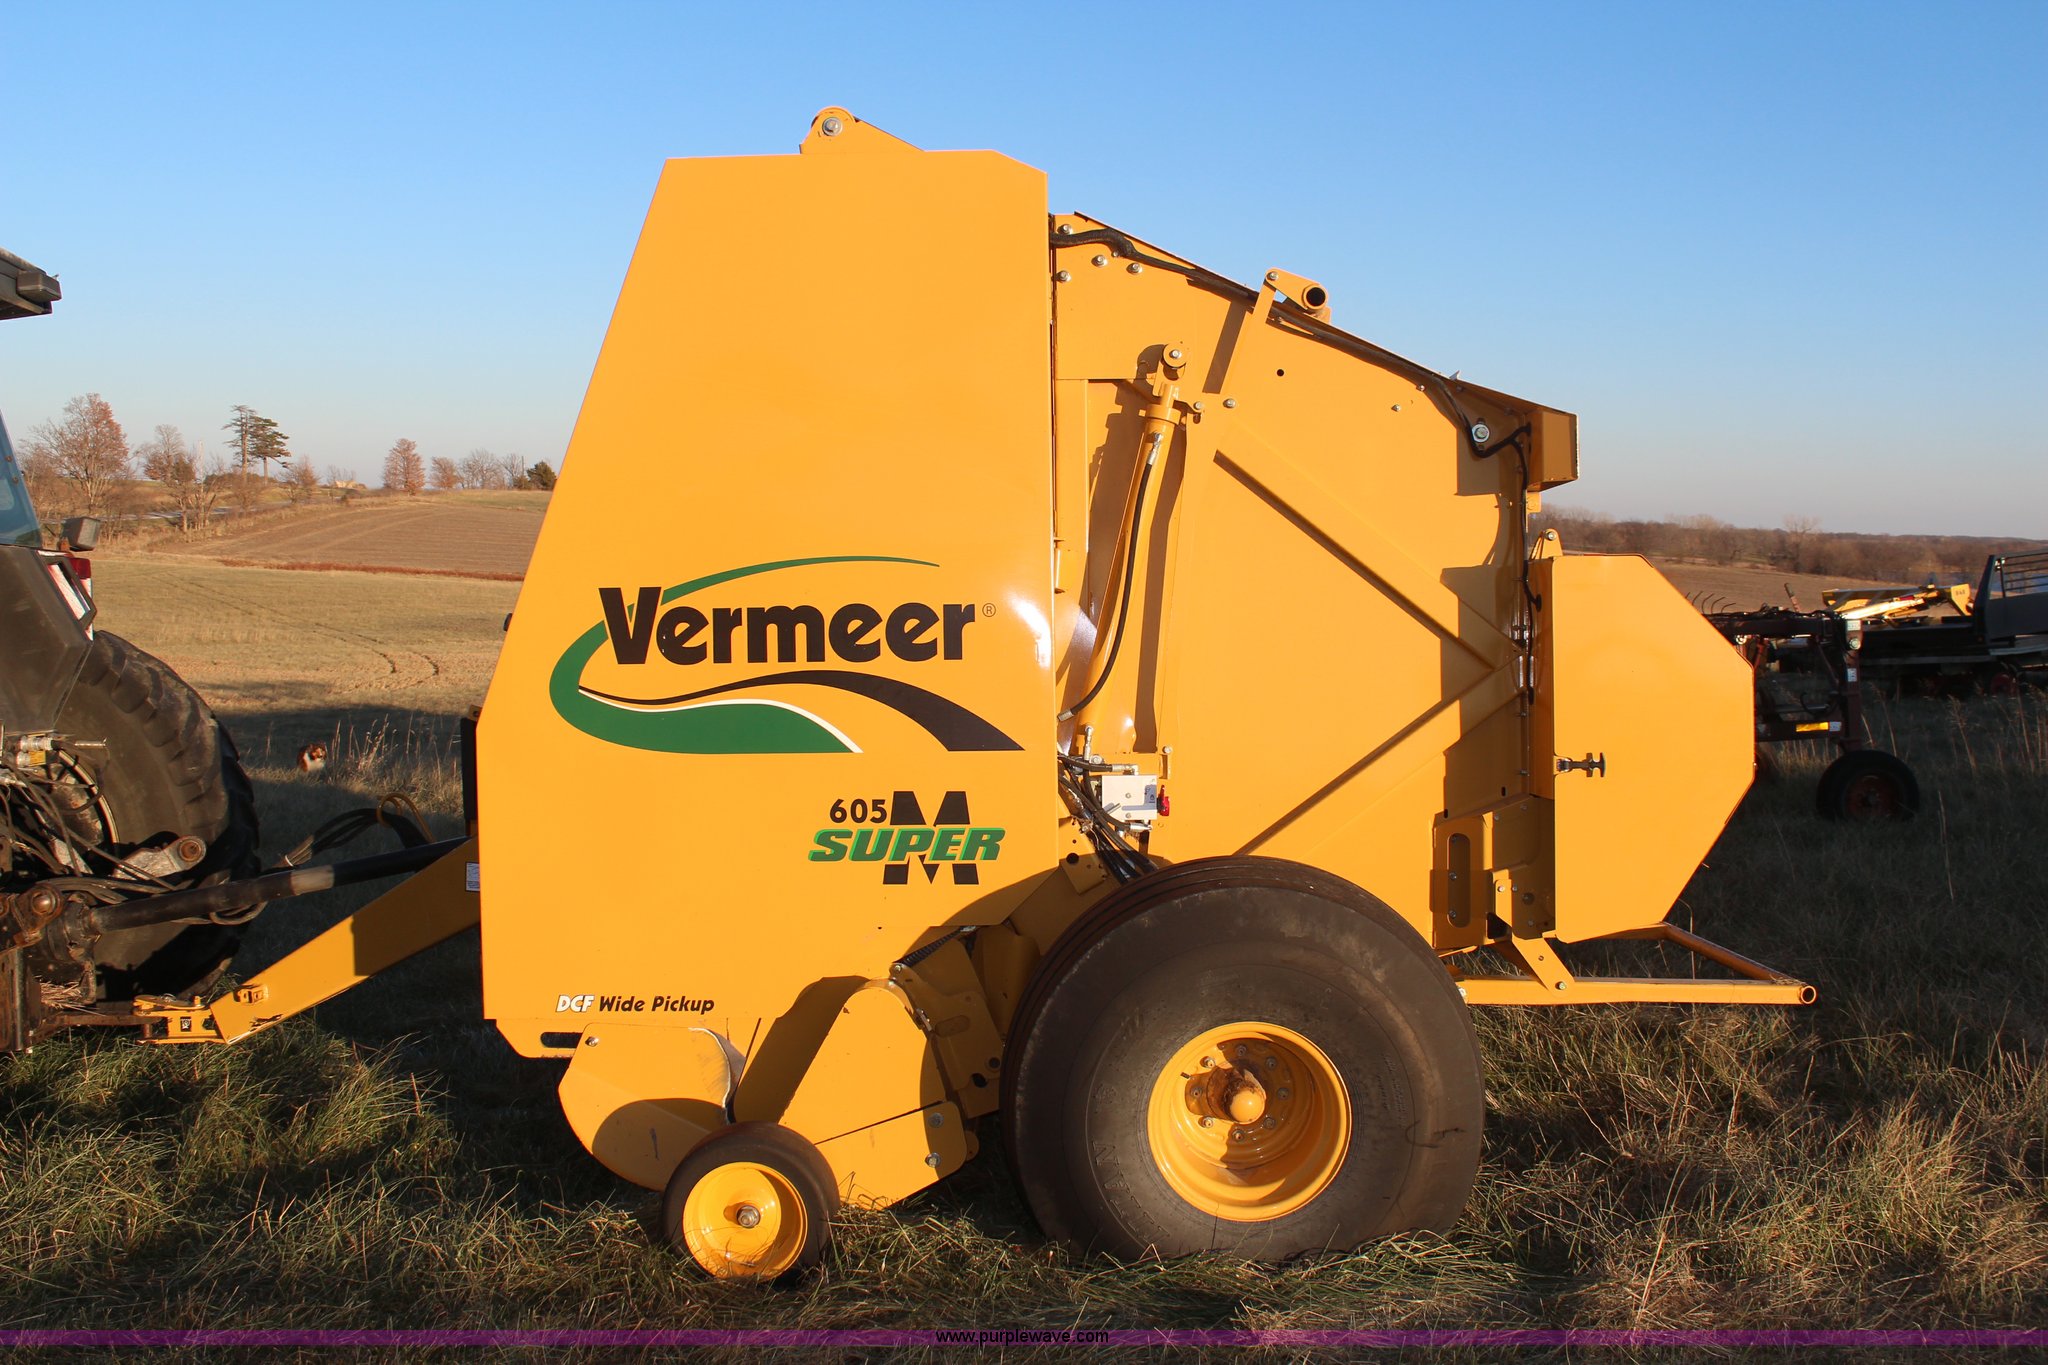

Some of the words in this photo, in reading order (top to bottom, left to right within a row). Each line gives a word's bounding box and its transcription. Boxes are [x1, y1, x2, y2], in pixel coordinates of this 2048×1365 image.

[598, 586, 976, 665] Vermeer
[829, 798, 888, 824] 605
[808, 827, 1006, 862] SUPER
[555, 994, 595, 1013] DCF
[599, 995, 645, 1012] Wide
[651, 995, 715, 1016] Pickup
